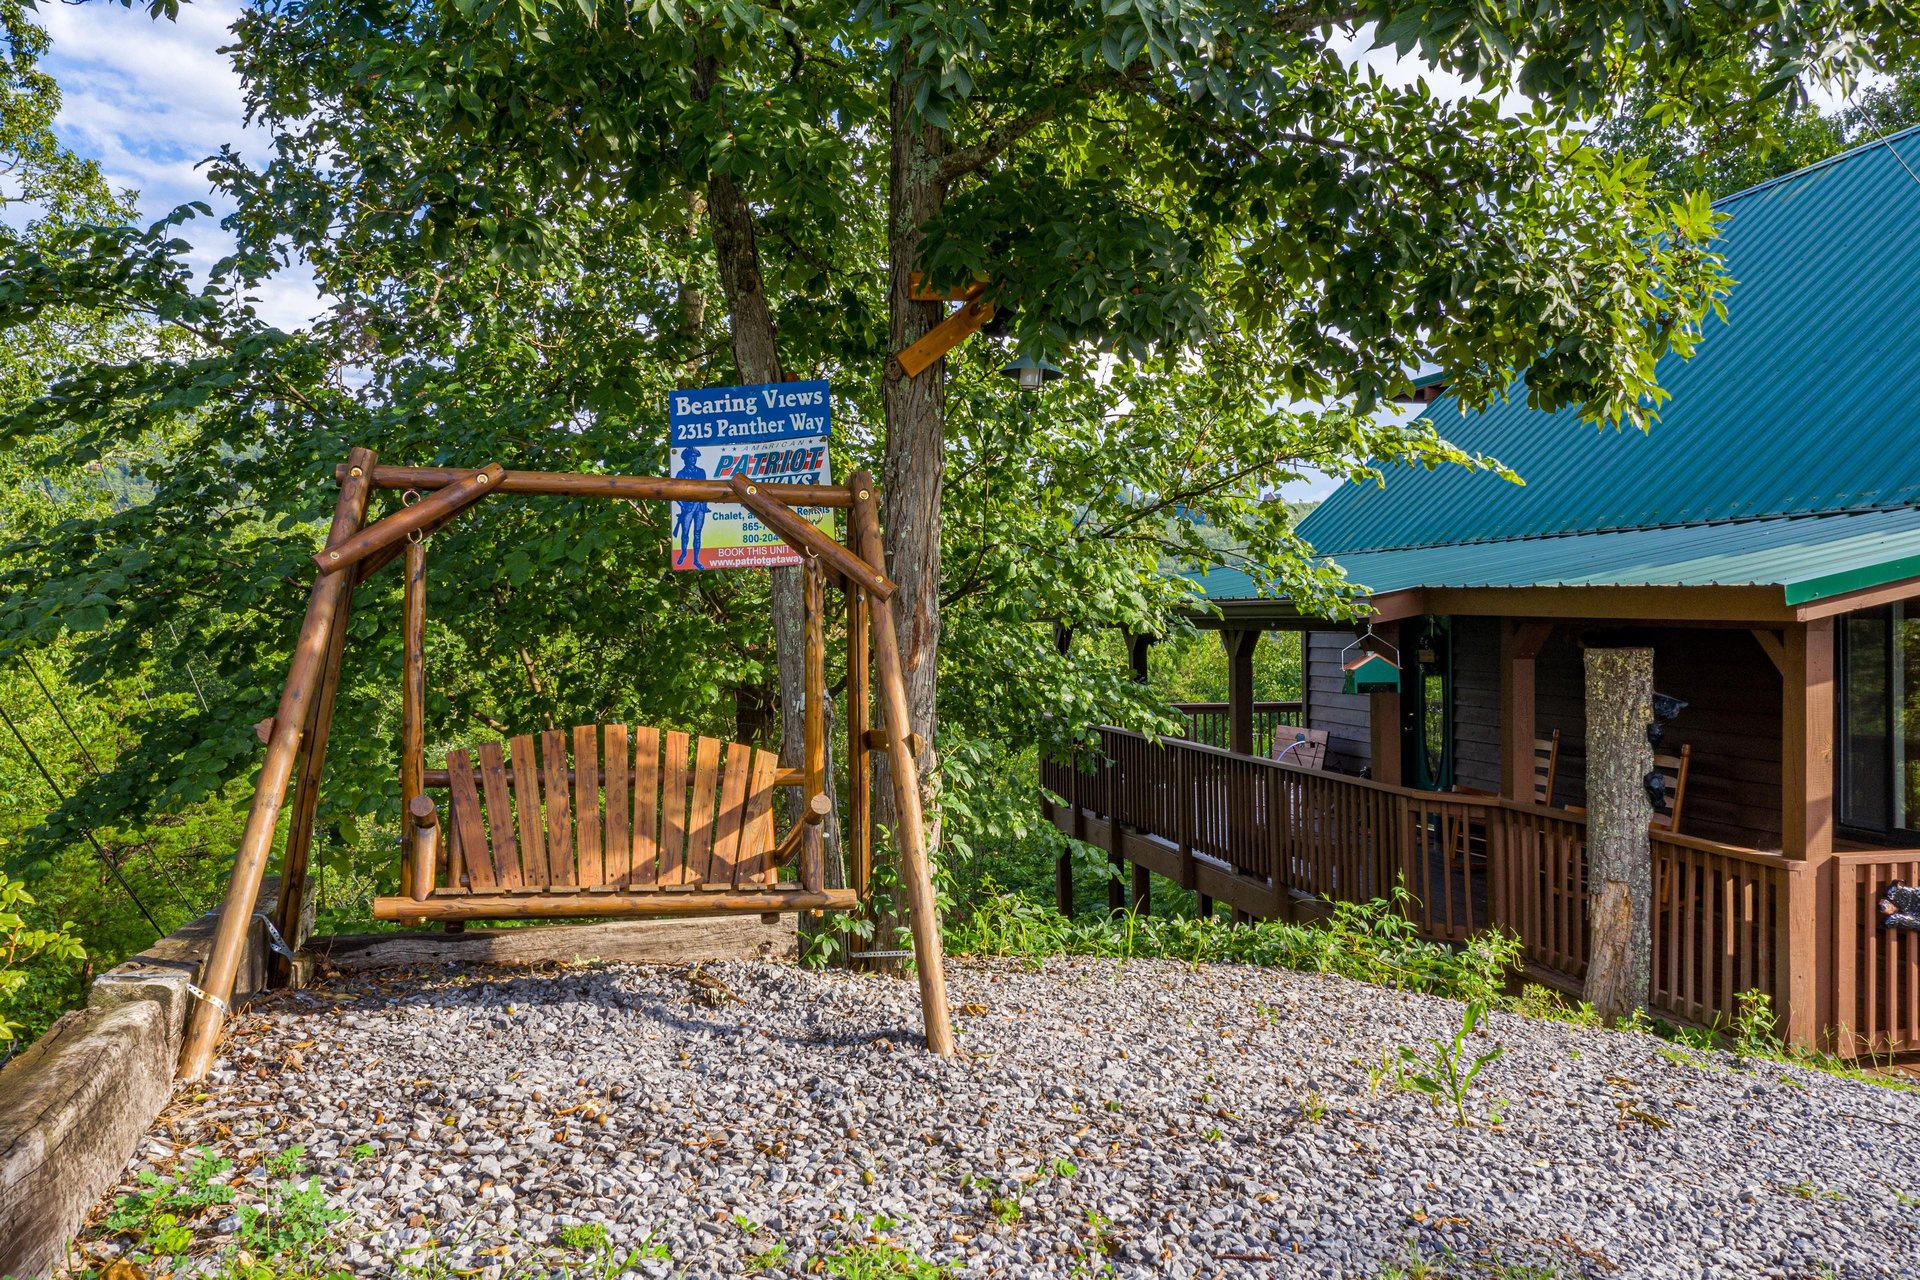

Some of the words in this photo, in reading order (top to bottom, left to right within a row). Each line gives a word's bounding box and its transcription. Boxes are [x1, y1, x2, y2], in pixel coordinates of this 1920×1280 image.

[675, 393, 758, 416] Bearing
[762, 389, 823, 409] Views
[677, 422, 713, 440] 2315
[716, 416, 785, 438] Panther
[789, 412, 824, 433] Way
[743, 439, 805, 451] AMERICAN
[713, 446, 825, 478] PATRIOT
[712, 511, 745, 521] Chalet,
[742, 533, 779, 543] 800-204
[718, 547, 745, 557] BOOK
[747, 546, 768, 556] THIS
[770, 545, 790, 555] UNIT
[709, 555, 804, 567] www.patriotgetaway
